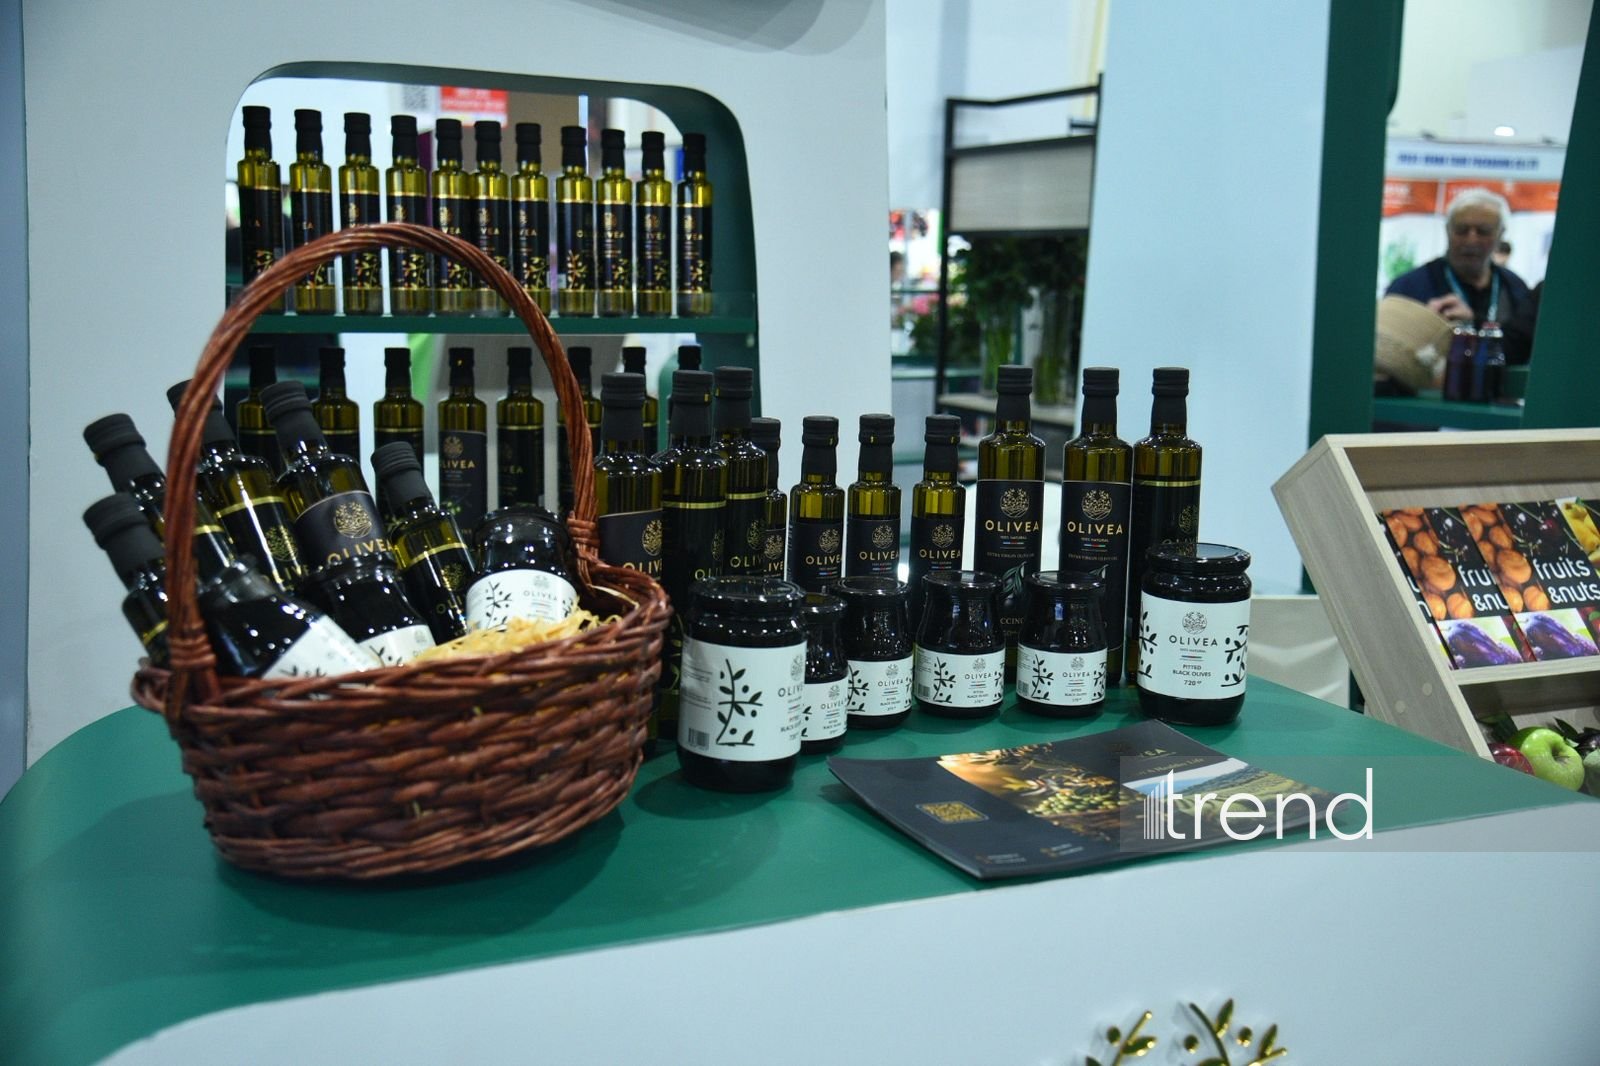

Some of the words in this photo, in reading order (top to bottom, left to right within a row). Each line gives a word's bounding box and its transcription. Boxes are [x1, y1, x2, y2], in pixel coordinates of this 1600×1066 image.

[985, 519, 1040, 533] OLIVEA
[1067, 520, 1123, 535] OLIVEA
[919, 549, 962, 559] OLIVEA
[1458, 564, 1497, 587] frui
[1532, 557, 1591, 580] fruits
[523, 589, 558, 601] OLIVEA
[1547, 581, 1600, 604] &nuts
[1472, 593, 1509, 612] &nu
[1169, 635, 1218, 647] OLIVEA
[877, 679, 903, 687] OLIVEA
[964, 672, 991, 680] OLIVEA
[777, 684, 803, 698] OLIV
